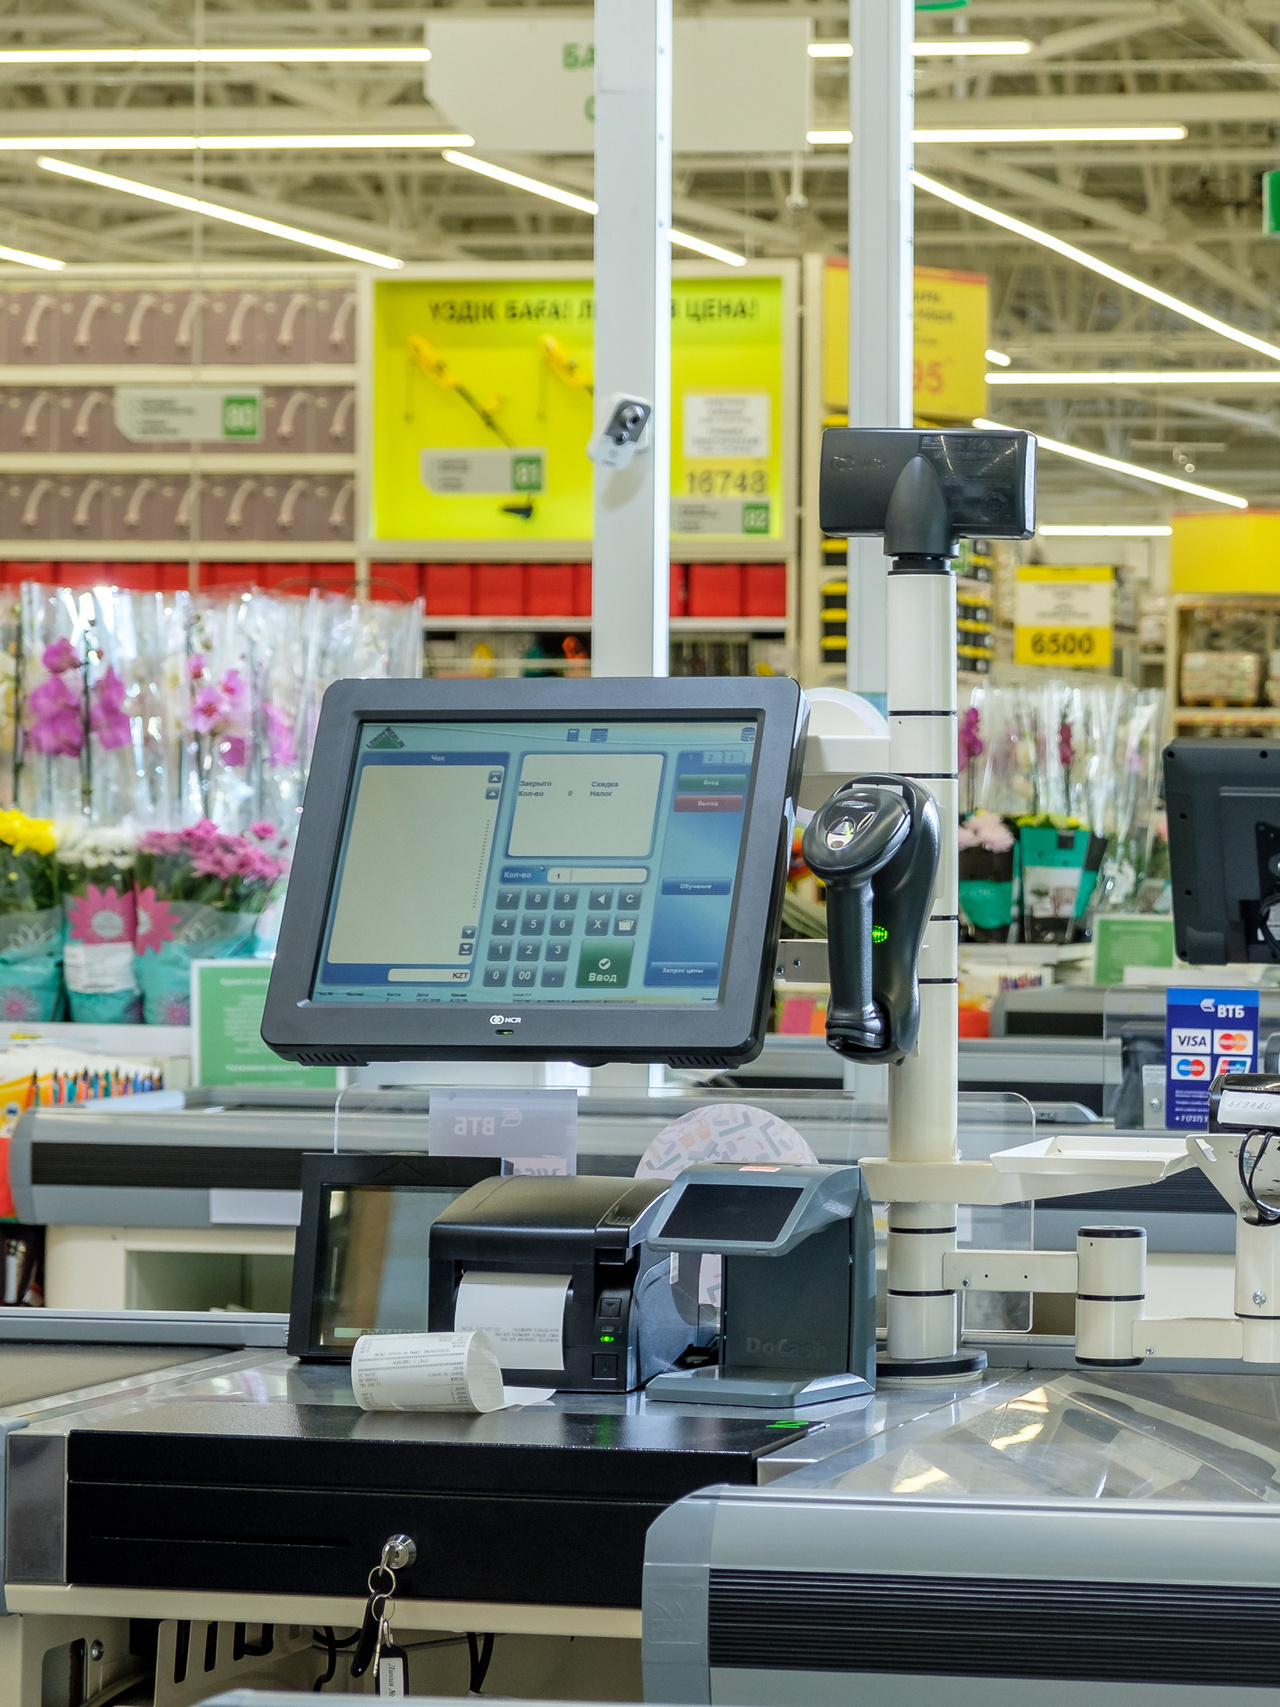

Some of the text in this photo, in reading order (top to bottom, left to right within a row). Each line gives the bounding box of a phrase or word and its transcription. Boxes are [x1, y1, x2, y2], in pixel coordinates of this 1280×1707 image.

[686, 297, 759, 323] ЦЕНА!
[1031, 632, 1095, 655] 6500
[431, 754, 446, 762] Чек
[519, 780, 619, 788] Закрыто Скидка
[589, 790, 613, 798] Налог
[503, 871, 532, 879] Кол-во
[518, 971, 531, 980] 00
[588, 972, 618, 983] Ввод
[1217, 1004, 1245, 1019] ВТБ
[1177, 1035, 1207, 1047] VISA
